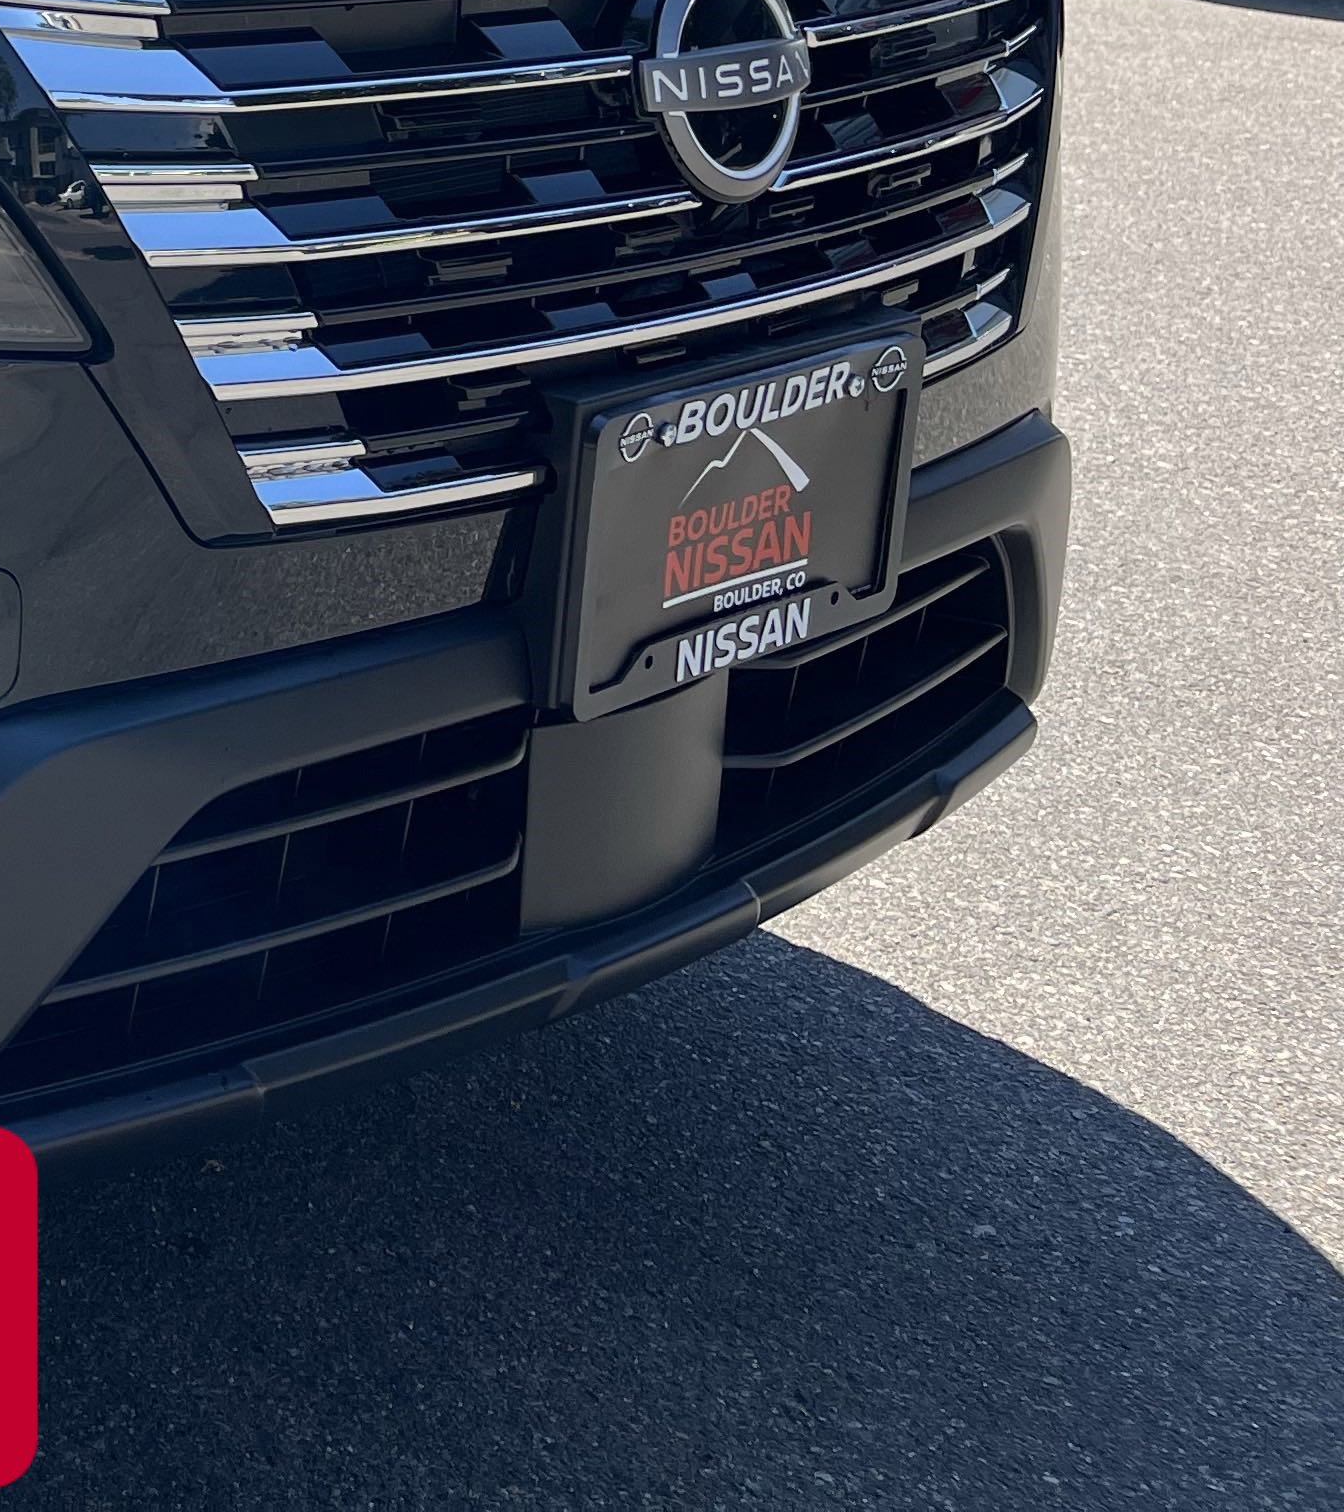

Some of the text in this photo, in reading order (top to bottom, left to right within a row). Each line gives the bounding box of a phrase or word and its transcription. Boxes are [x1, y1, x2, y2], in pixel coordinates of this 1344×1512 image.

[871, 361, 908, 378] NISSAN
[675, 361, 851, 445] BOULDER
[620, 427, 655, 447] NISSAN
[668, 484, 793, 548] BOULDER
[664, 510, 813, 598] NISSAN
[713, 570, 807, 613] BOULDER, CO
[676, 597, 812, 683] NISSAN
